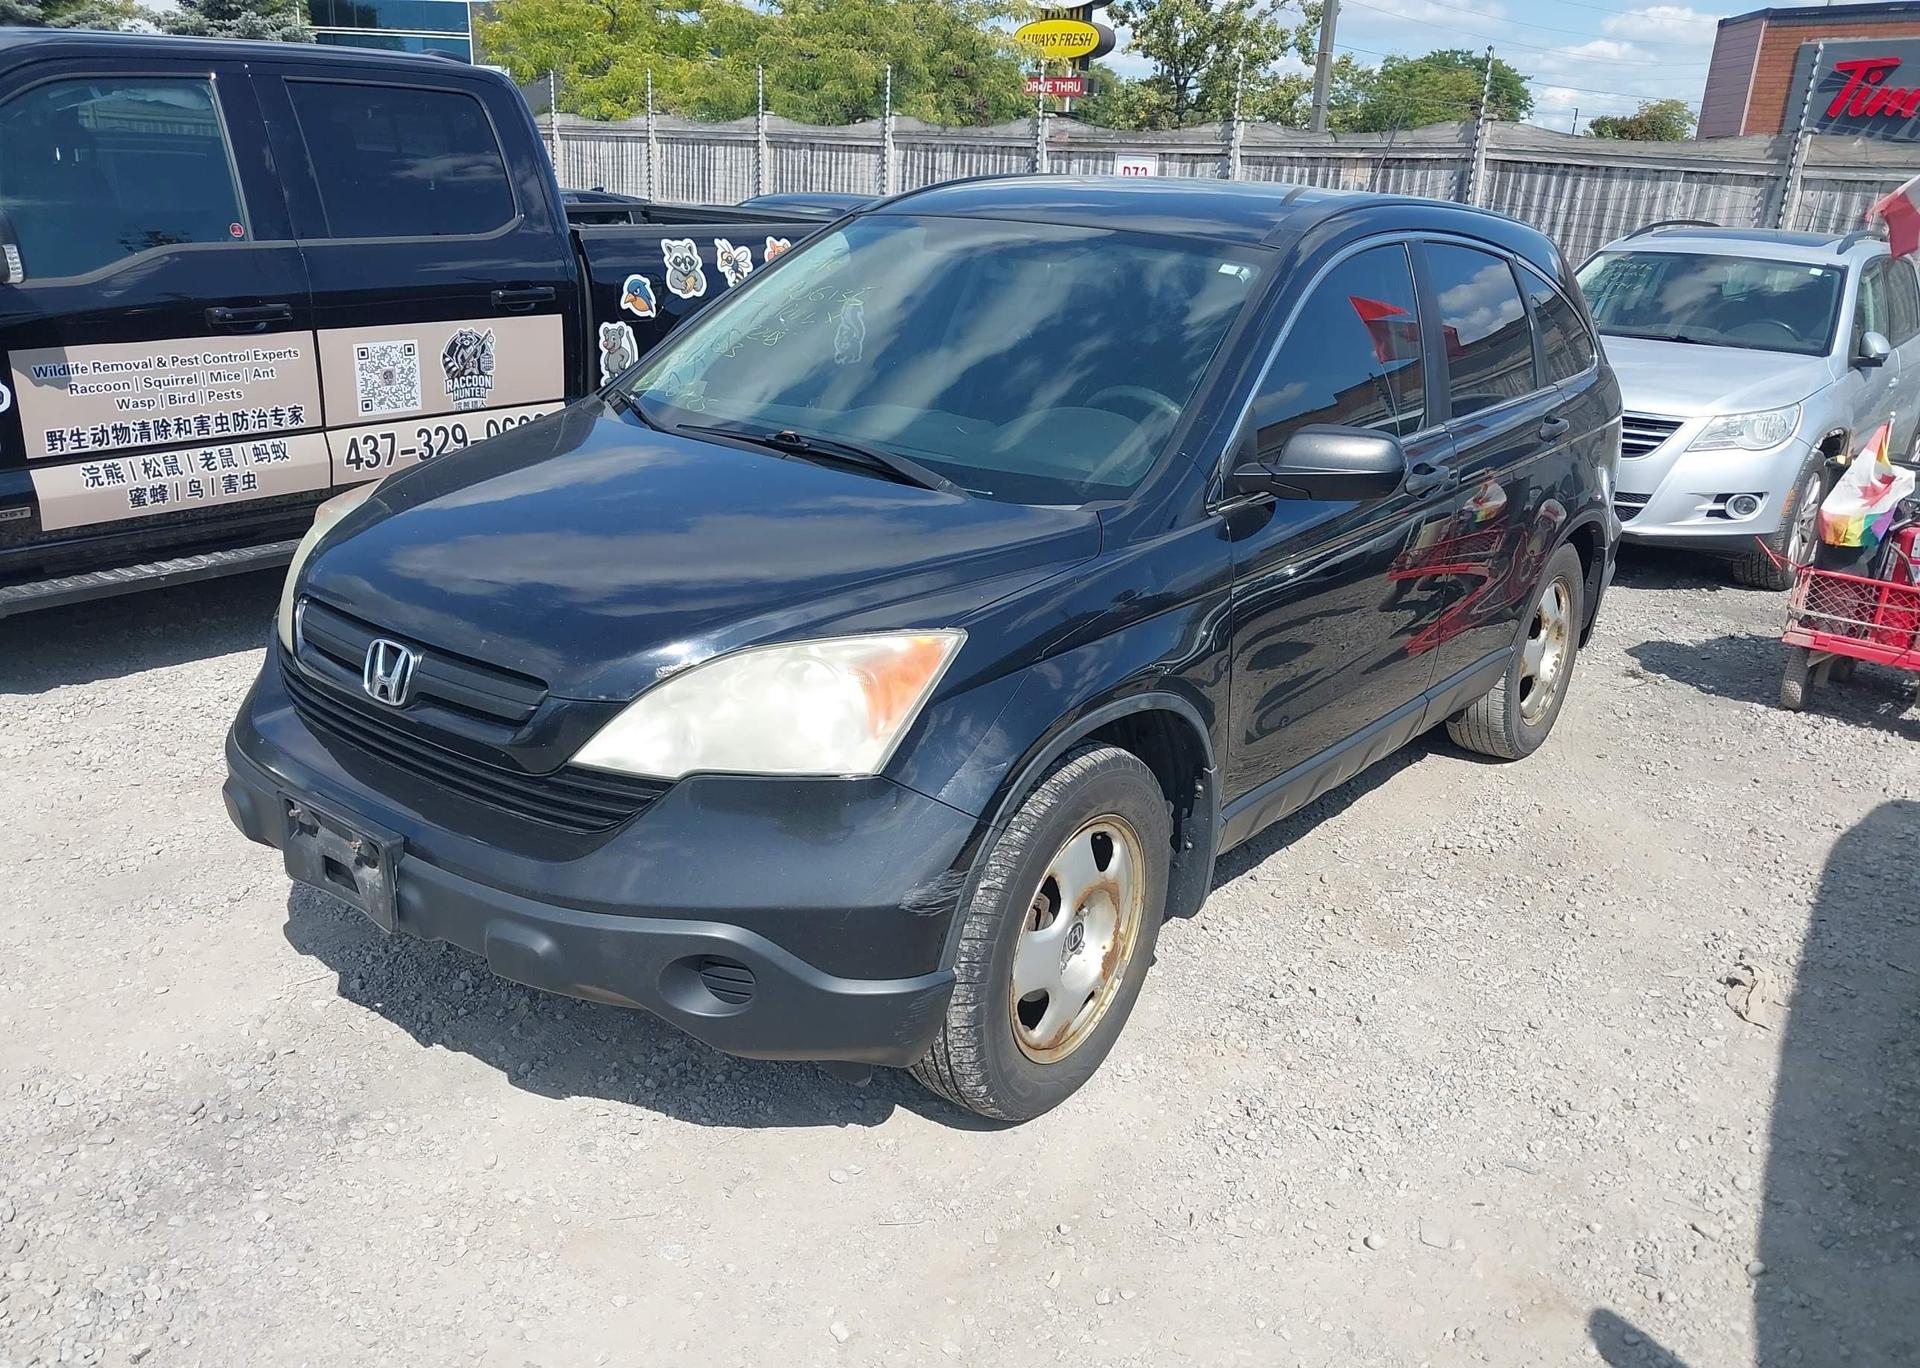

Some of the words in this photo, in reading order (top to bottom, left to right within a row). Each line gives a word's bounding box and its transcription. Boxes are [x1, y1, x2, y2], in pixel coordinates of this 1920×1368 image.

[1058, 33, 1094, 46] FRESH
[1026, 80, 1053, 92] DRVE
[1054, 80, 1081, 92] THRU
[1827, 57, 1920, 118] Tim
[33, 363, 88, 378] Wildlife
[92, 358, 152, 374] Removal
[156, 356, 168, 368] &
[171, 354, 200, 367] Pest
[203, 351, 251, 364] Control
[254, 348, 300, 363] Experts
[69, 380, 131, 395] Raccoon
[143, 373, 198, 390] Squirrel
[210, 370, 241, 383] Mice
[253, 368, 276, 380] Ant
[446, 374, 493, 394] RACCOON
[453, 387, 487, 401] HUNTER
[116, 396, 155, 411] Wasp
[168, 392, 196, 406] Bird
[208, 388, 243, 402] Pests
[46, 405, 305, 452] 野生动物清除和害虫防治专家
[346, 413, 546, 471] 437-329-0
[81, 462, 126, 488] 浣熊
[141, 454, 184, 479] 松鼠
[199, 447, 239, 470] 老鼠
[252, 440, 290, 464] 蚂蚁
[129, 484, 169, 508] 蜜蜂
[187, 479, 205, 499] 鸟
[222, 471, 258, 494] 害虫
